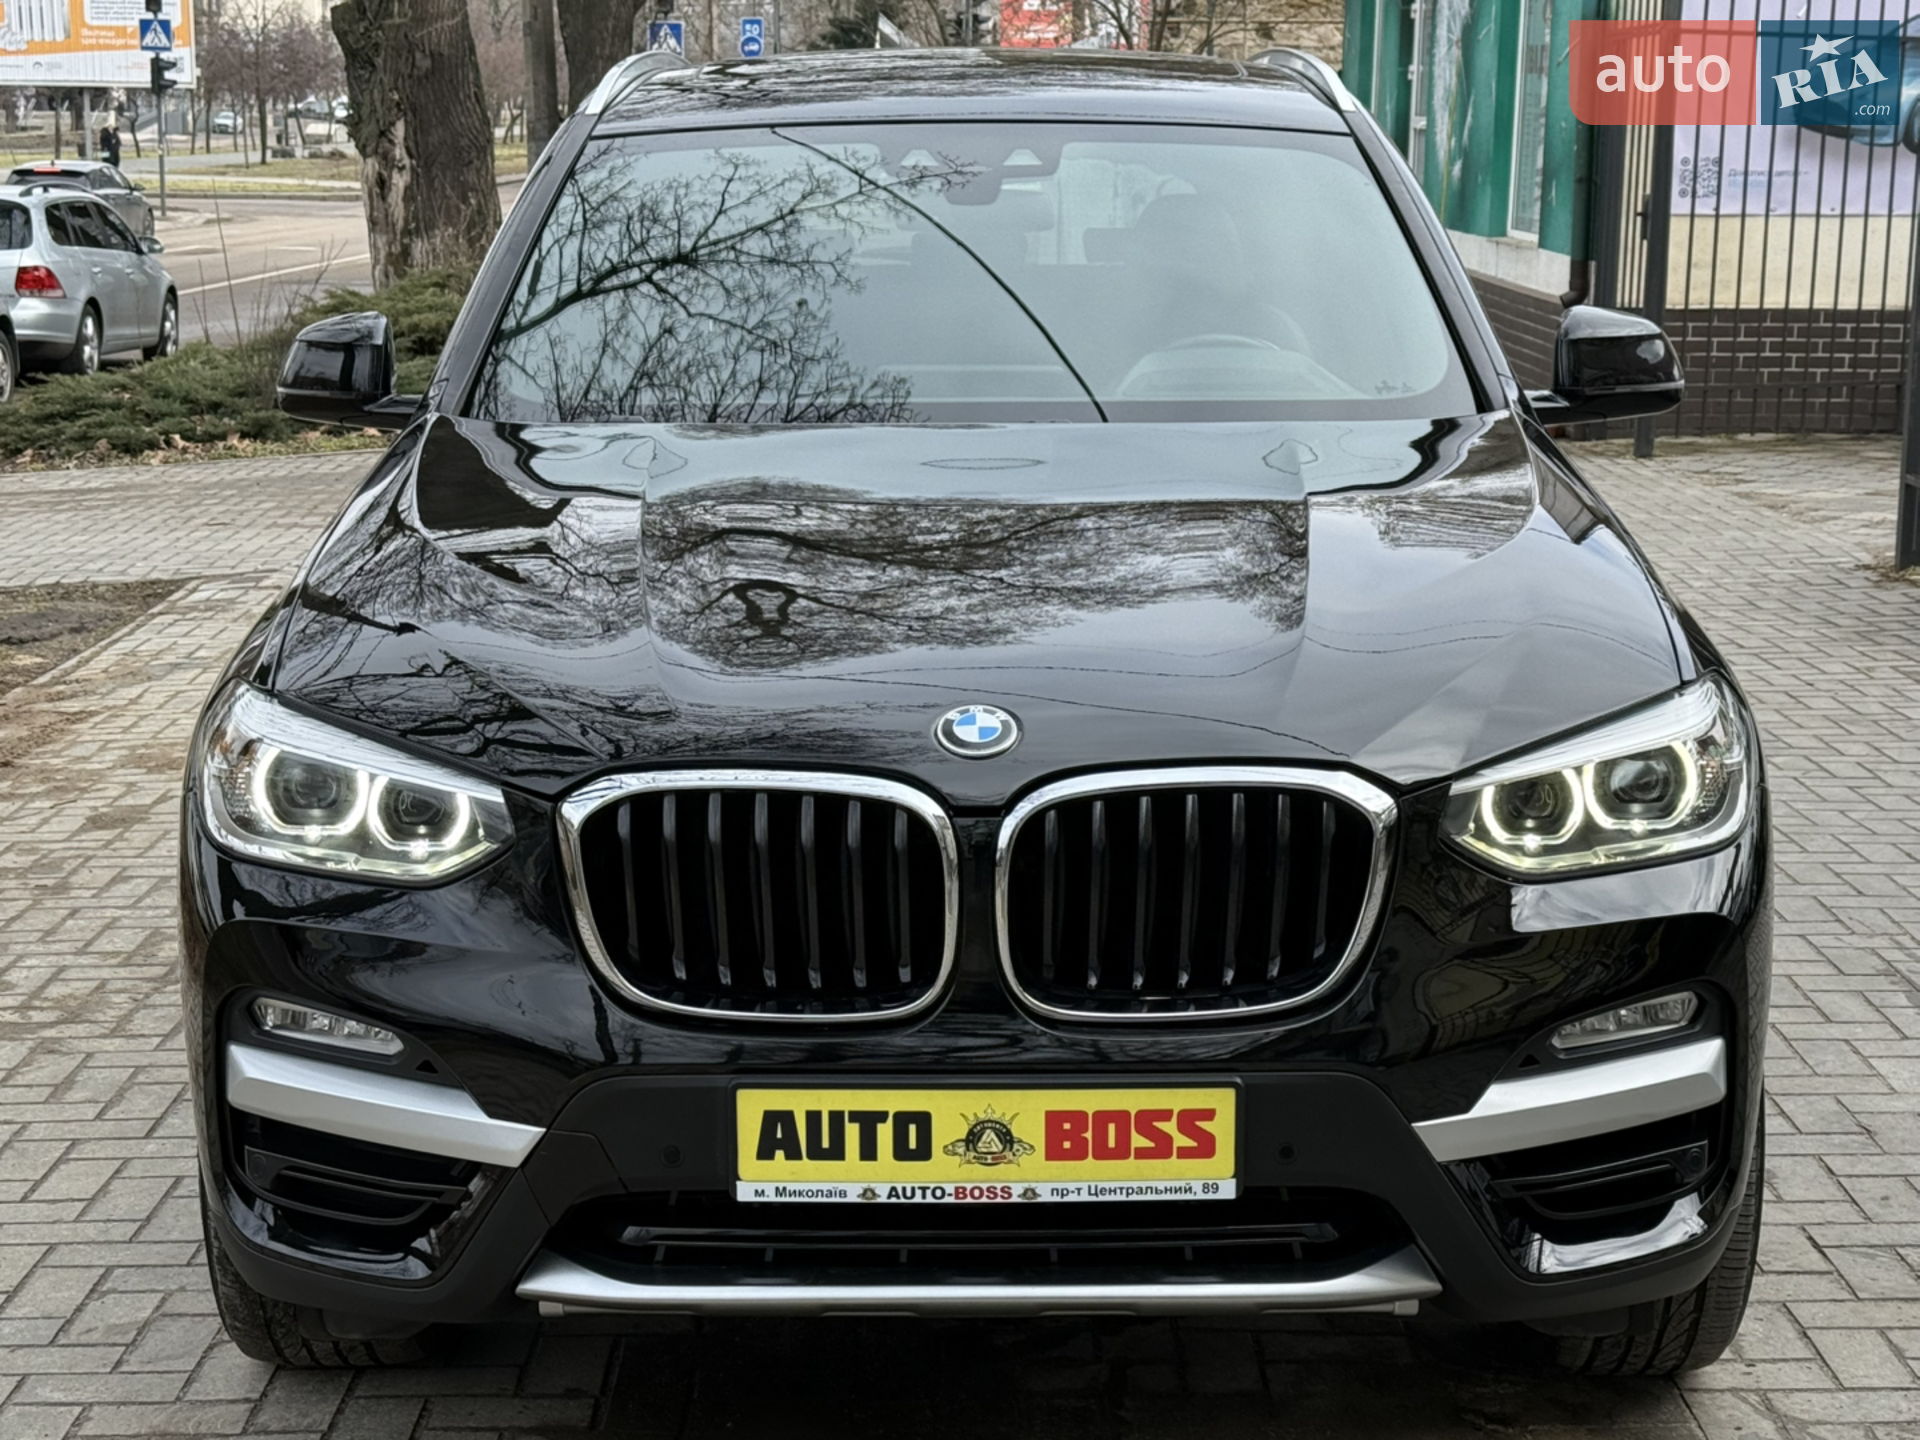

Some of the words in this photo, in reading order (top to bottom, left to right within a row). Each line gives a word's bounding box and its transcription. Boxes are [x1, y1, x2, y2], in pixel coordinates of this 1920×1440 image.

[755, 1109, 933, 1162] AUTO
[1044, 1108, 1217, 1162] BOSS
[754, 1188, 770, 1198] м.
[775, 1186, 848, 1199] Миколаїв
[886, 1185, 1013, 1200] AUTO-BOSS
[1050, 1186, 1083, 1198] пр-т
[1087, 1184, 1198, 1198] Центральний,
[1201, 1182, 1220, 1195] 89
